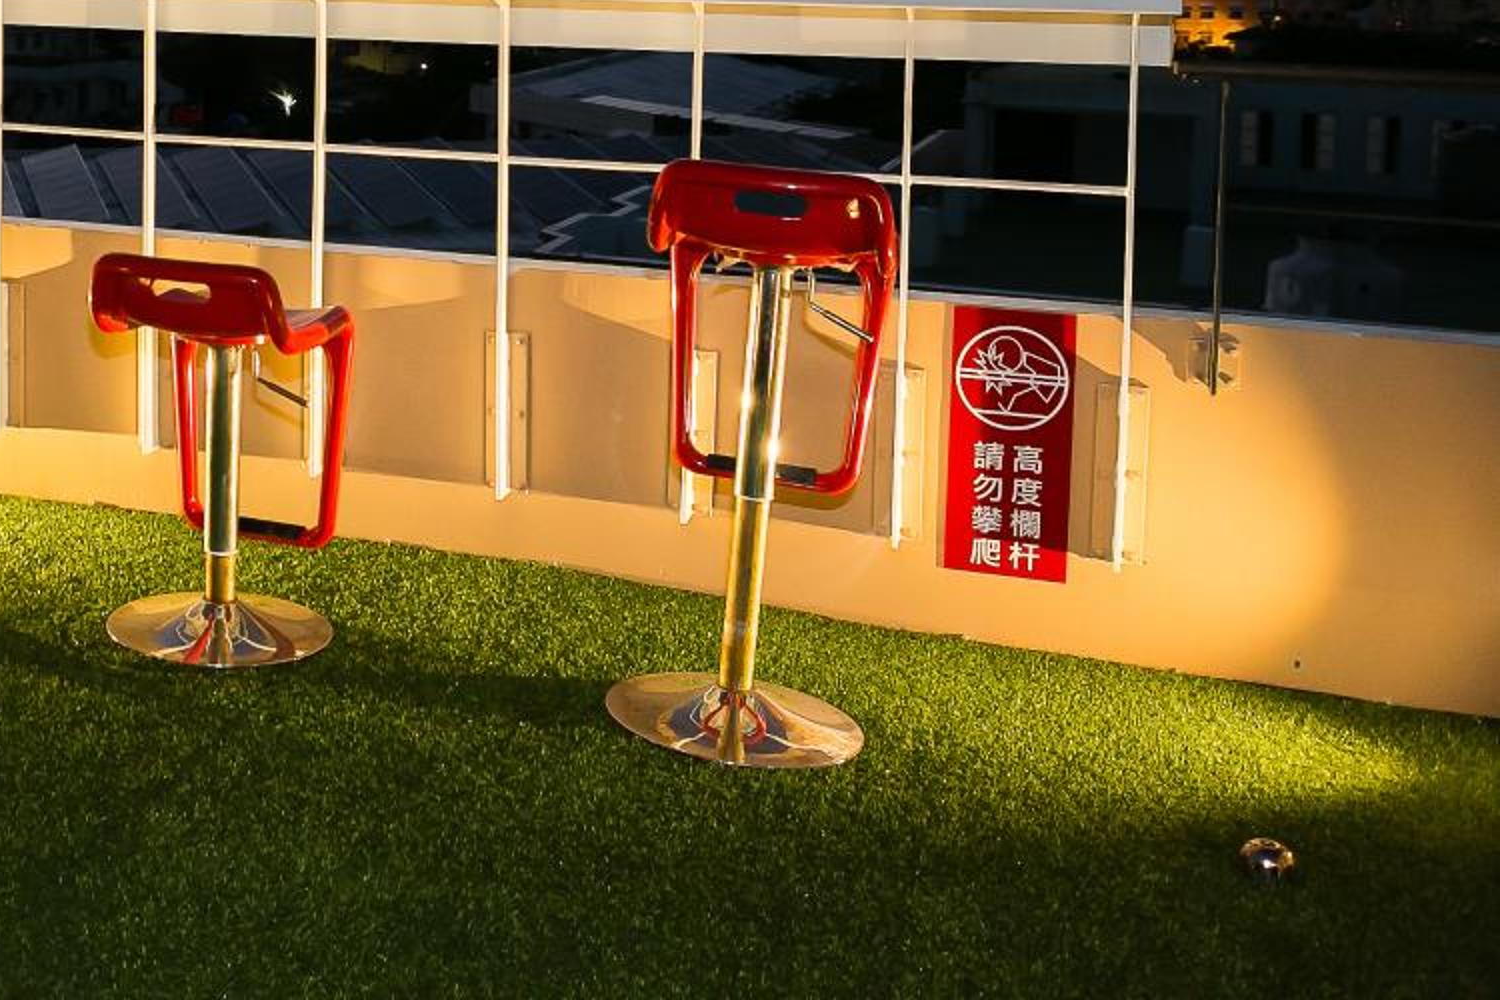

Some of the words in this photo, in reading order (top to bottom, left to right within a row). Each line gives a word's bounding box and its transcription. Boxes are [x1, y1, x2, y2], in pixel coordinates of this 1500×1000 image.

[969, 440, 1004, 567] 請勿攀爬
[1008, 444, 1044, 572] 高度欄杆
